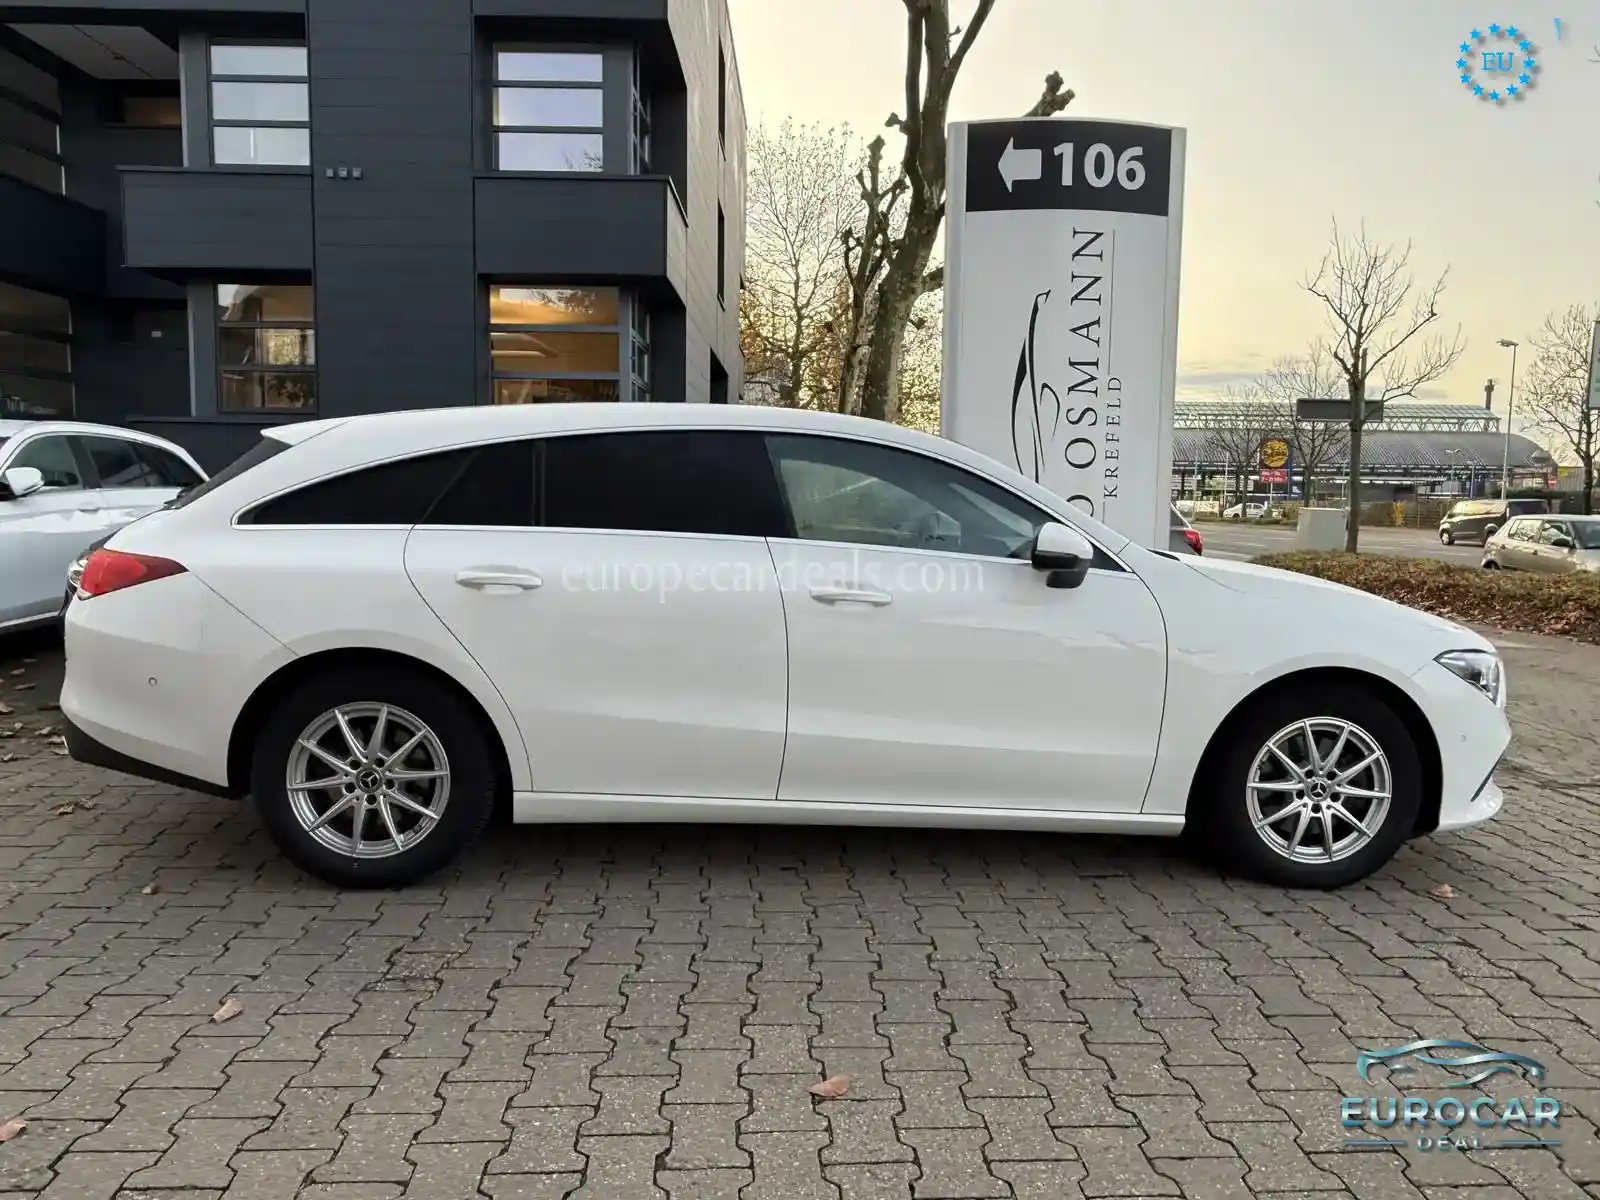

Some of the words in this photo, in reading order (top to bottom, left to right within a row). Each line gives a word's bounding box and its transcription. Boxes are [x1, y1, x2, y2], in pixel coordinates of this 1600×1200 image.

[1053, 142, 1146, 190] 106
[1065, 227, 1105, 469] OSMANN
[1103, 376, 1122, 499] KREFELD
